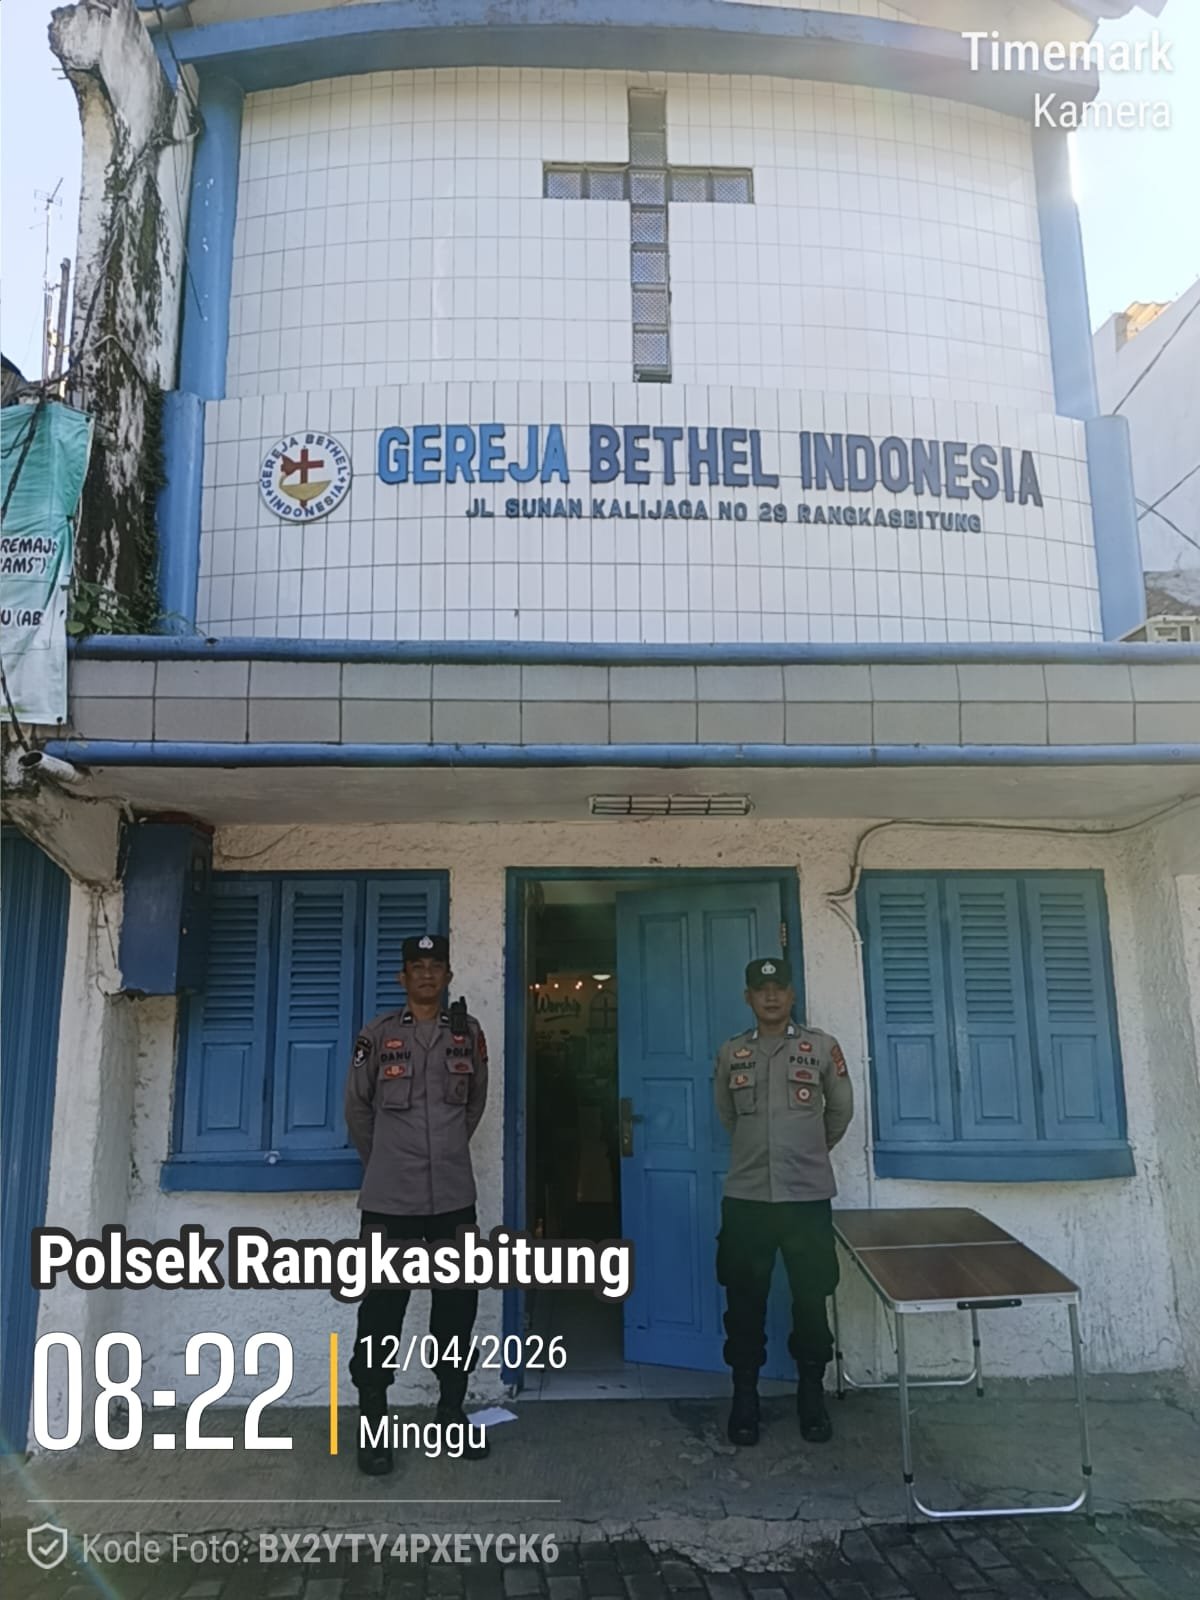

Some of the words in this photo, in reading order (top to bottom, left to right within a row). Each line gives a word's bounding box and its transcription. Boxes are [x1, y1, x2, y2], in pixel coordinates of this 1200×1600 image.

[260, 437, 299, 489] GEREJA
[305, 433, 348, 475] BETHEL
[377, 423, 570, 485] GEREJA
[589, 425, 779, 488] BETHEL
[799, 431, 1044, 507] INDONESIA
[269, 483, 345, 518] INDONESIA
[466, 498, 494, 518] JL
[505, 498, 583, 519] SUNAN
[592, 499, 709, 520] KALIJAGA
[718, 501, 748, 522] NO
[759, 502, 788, 523] 29
[797, 503, 982, 533] RANGKASBITUNG
[789, 1055, 820, 1067] POLRI
